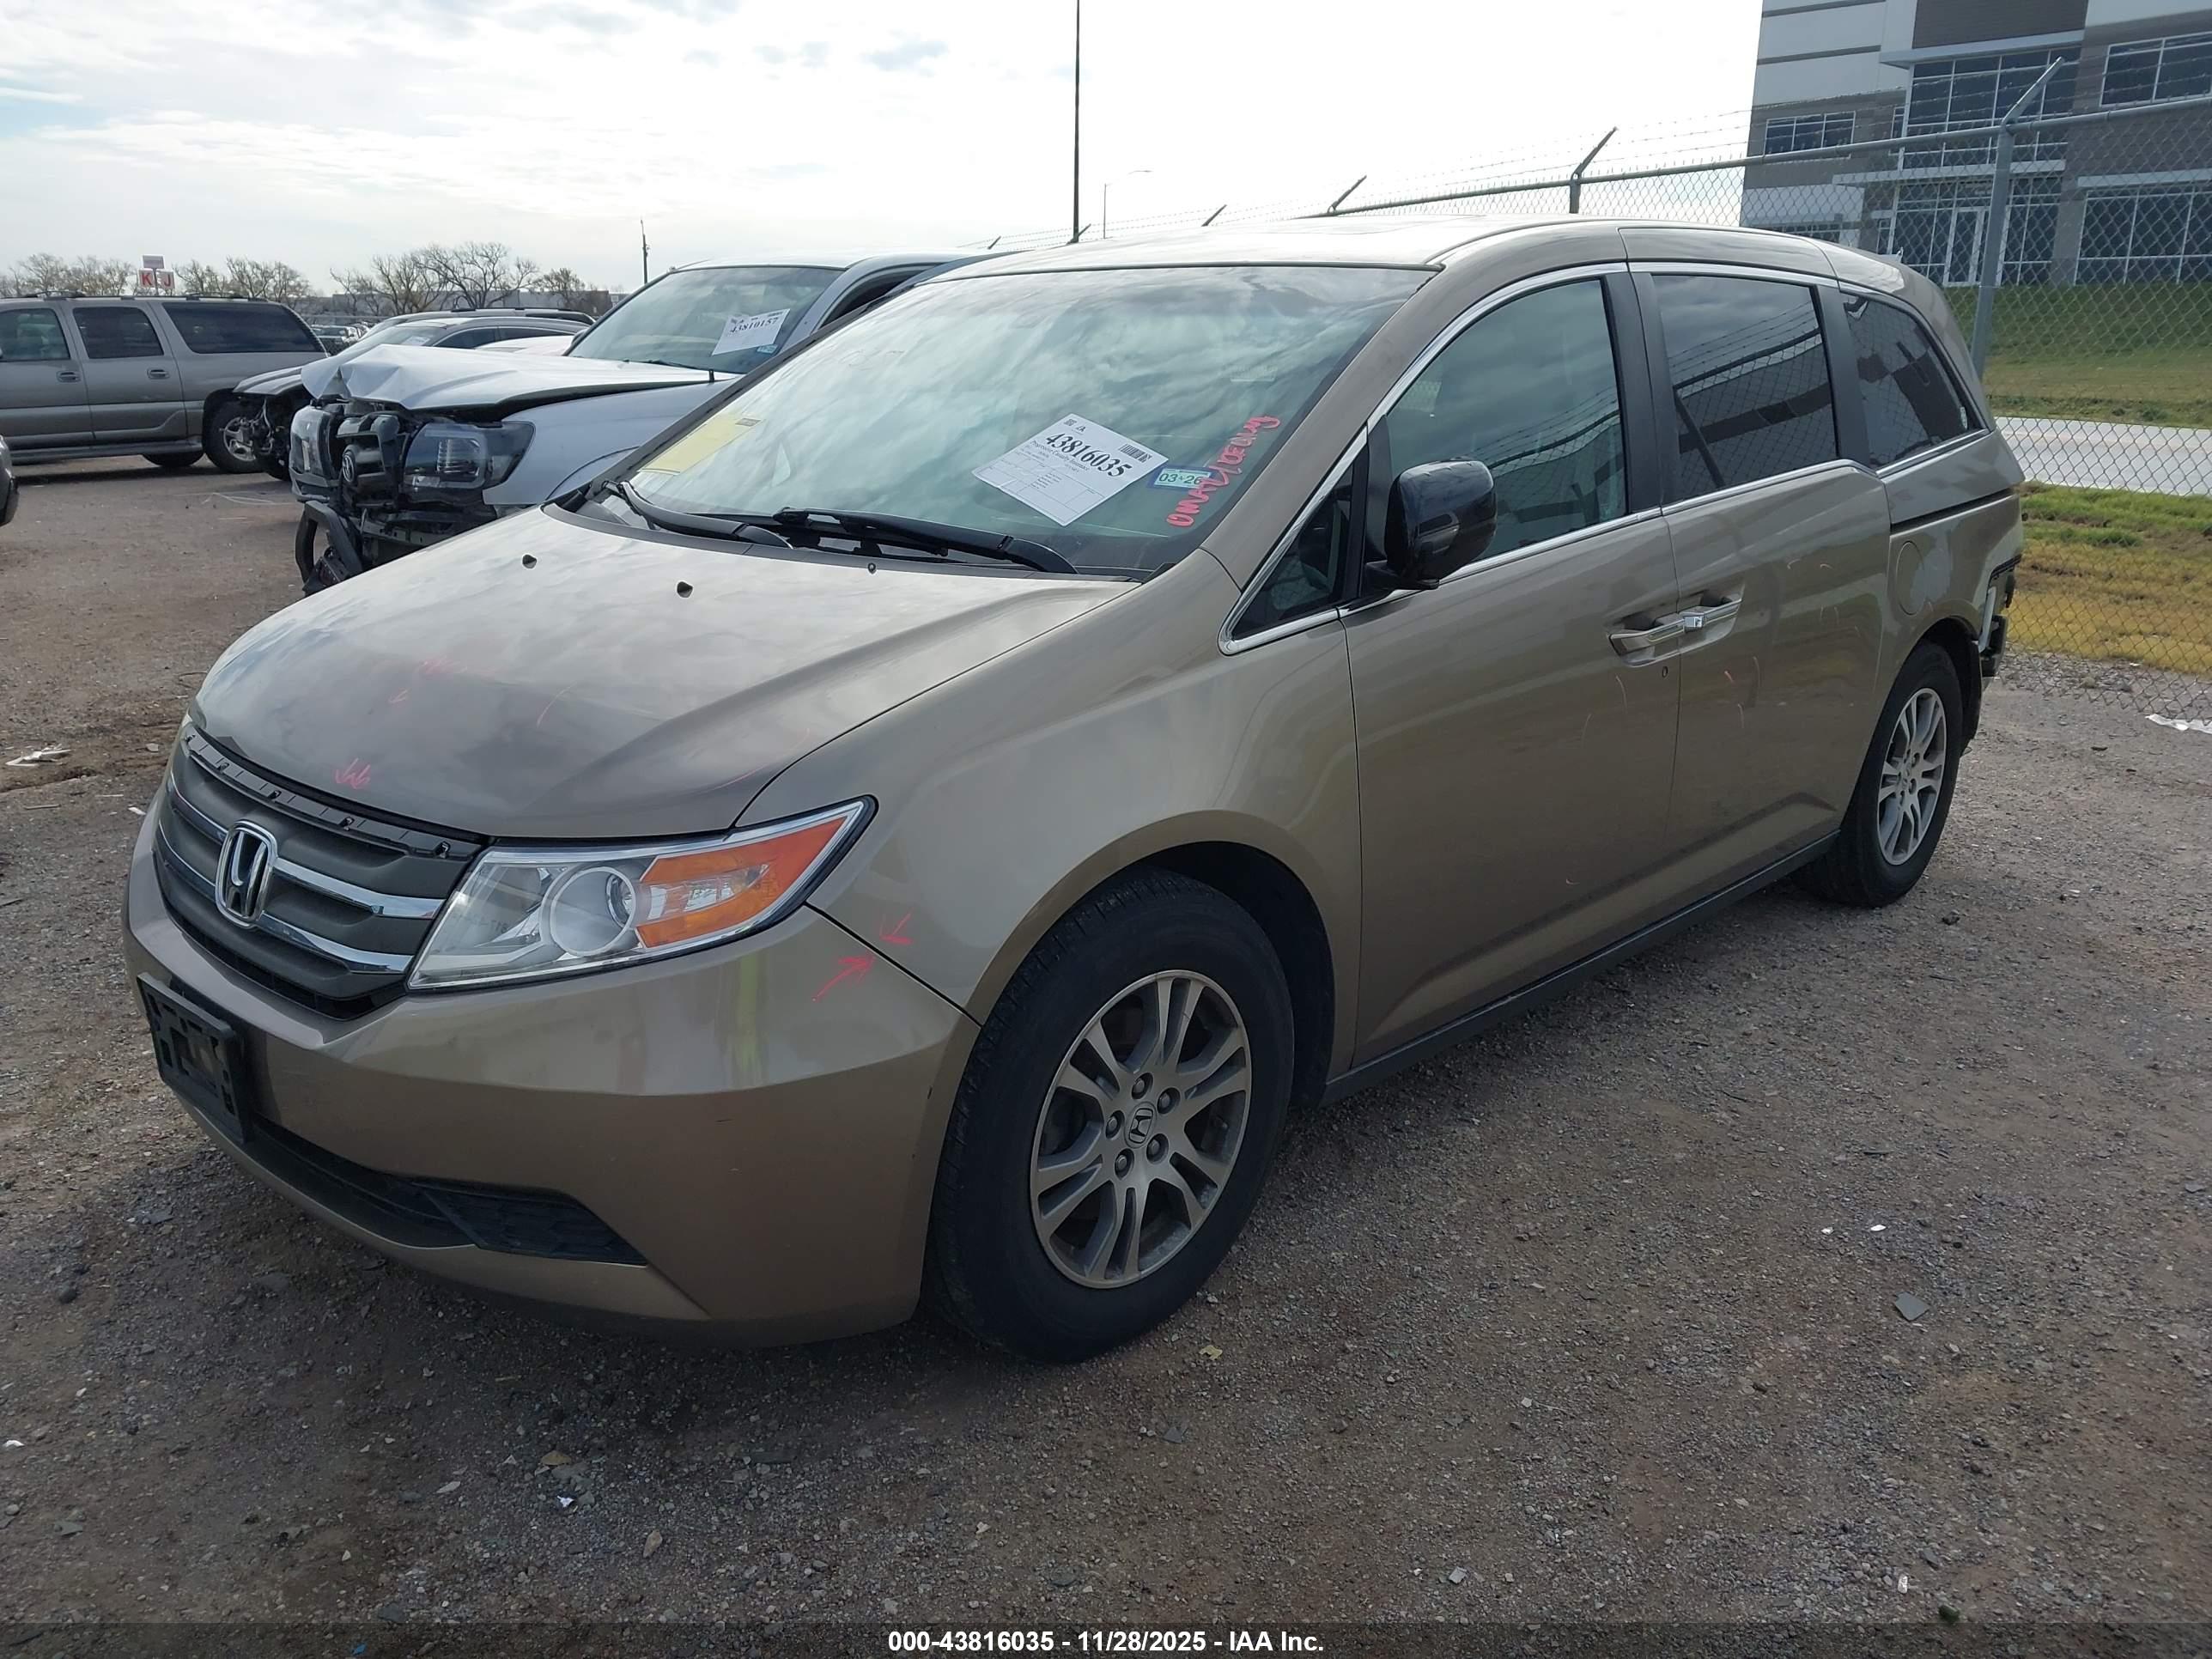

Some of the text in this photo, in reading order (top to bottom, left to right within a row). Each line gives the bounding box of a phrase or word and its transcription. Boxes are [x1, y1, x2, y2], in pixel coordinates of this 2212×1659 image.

[141, 272, 172, 287] K J
[1045, 432, 1133, 478] 43816035
[1158, 472, 1179, 483] 03
